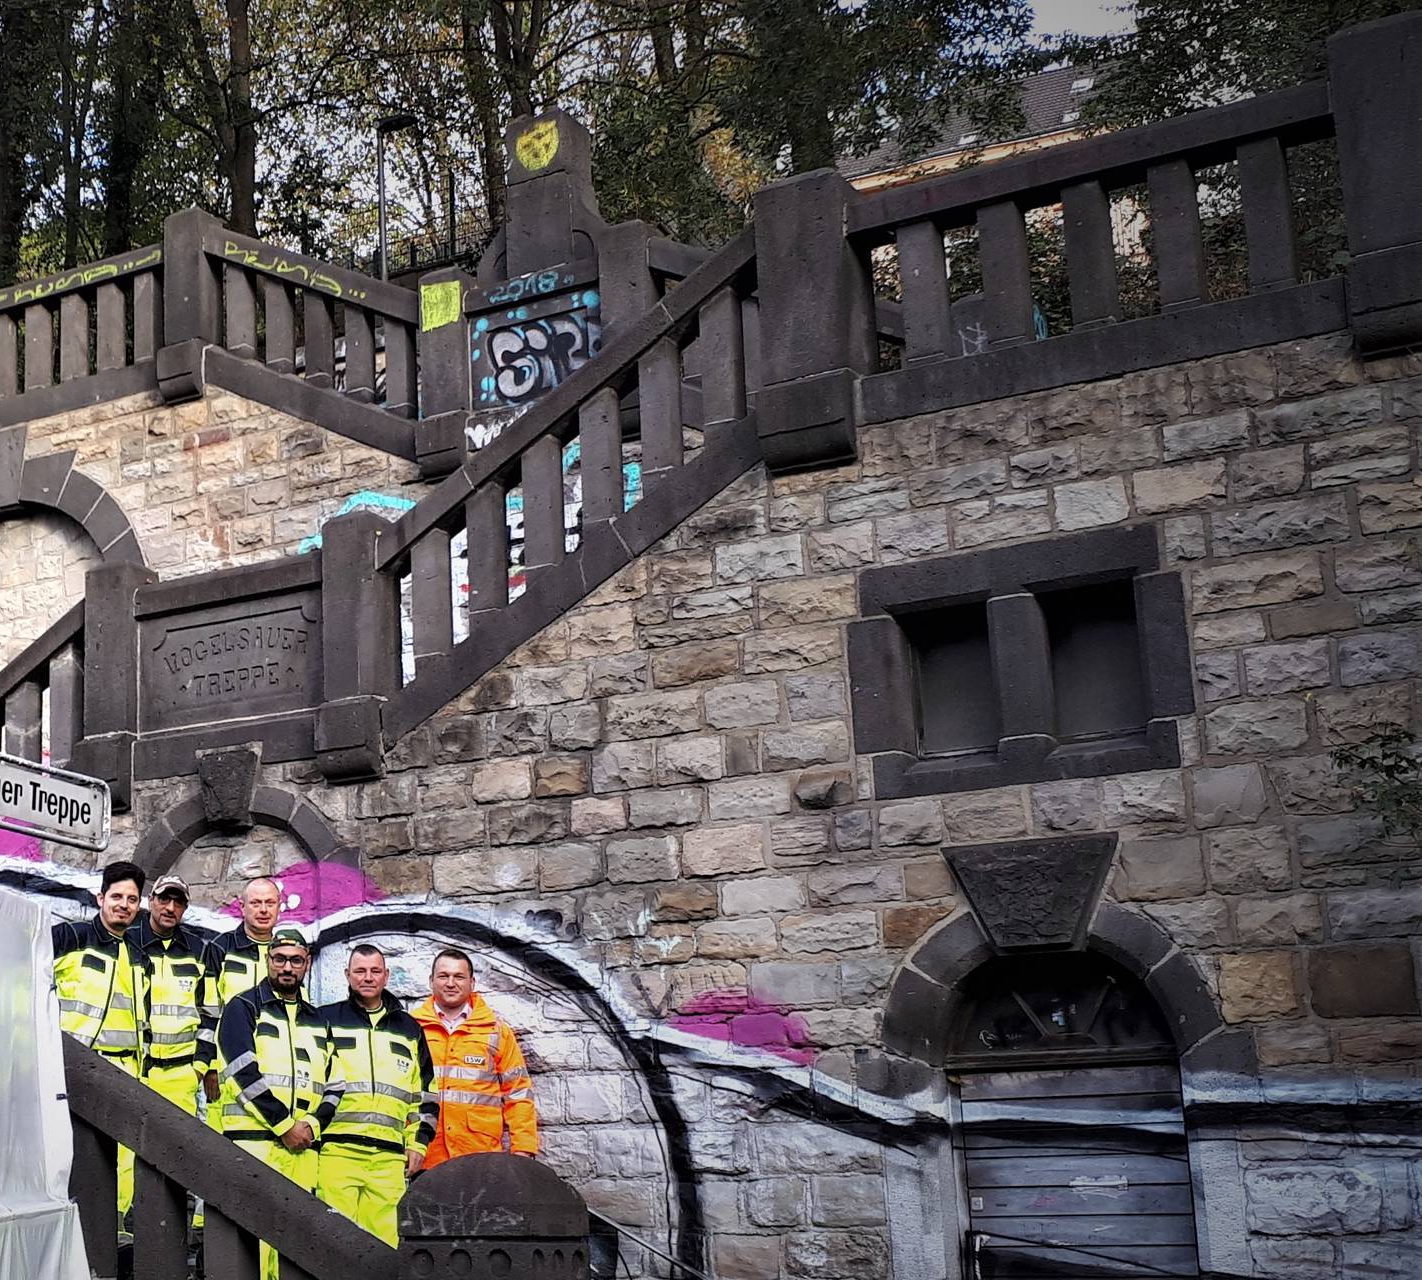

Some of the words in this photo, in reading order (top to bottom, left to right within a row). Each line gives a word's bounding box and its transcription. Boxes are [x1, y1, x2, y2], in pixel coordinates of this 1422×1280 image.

[163, 625, 309, 676] VOGELSAUER
[192, 662, 280, 697] TREPPE
[29, 780, 91, 827] Treppe
